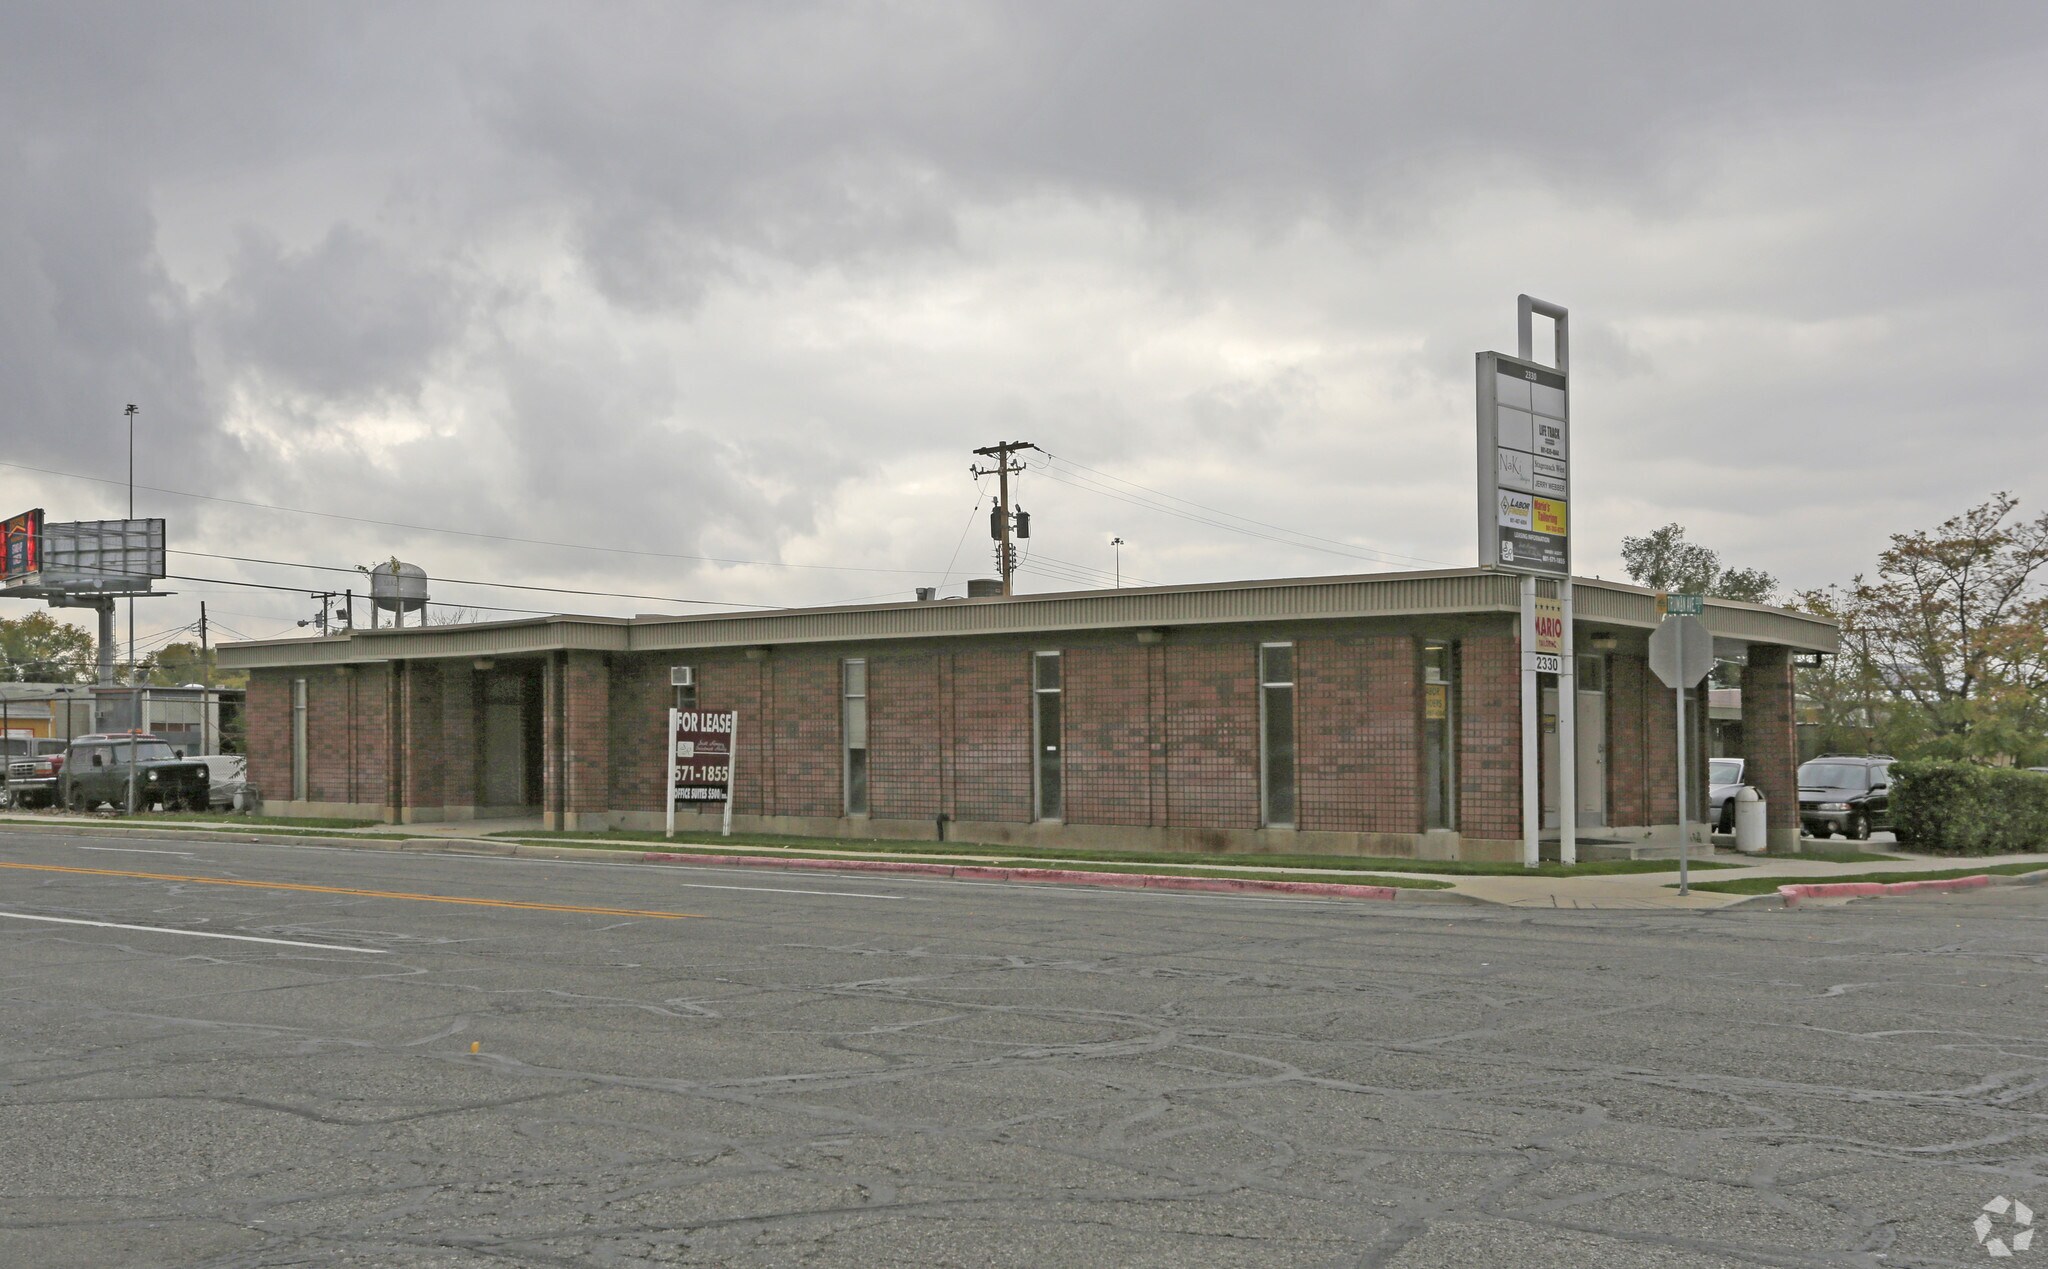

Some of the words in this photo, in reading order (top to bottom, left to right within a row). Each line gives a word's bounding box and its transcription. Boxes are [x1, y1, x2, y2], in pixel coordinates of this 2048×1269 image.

[1525, 370, 1537, 380] 2330
[1539, 424, 1547, 437] LIFE
[1547, 425, 1560, 439] TRACK
[1535, 480, 1547, 489] JERRY
[1548, 483, 1565, 492] WEBBER
[1510, 498, 1530, 510] LABOR
[1538, 511, 1557, 525] Tailoring
[1528, 534, 1550, 543] INFORMATION
[1536, 656, 1558, 671] 2330
[677, 712, 698, 732] FOR
[701, 713, 732, 733] LEASE
[675, 765, 728, 781] 571-1855
[675, 787, 690, 799] OFFICE
[691, 788, 707, 799] SUITES
